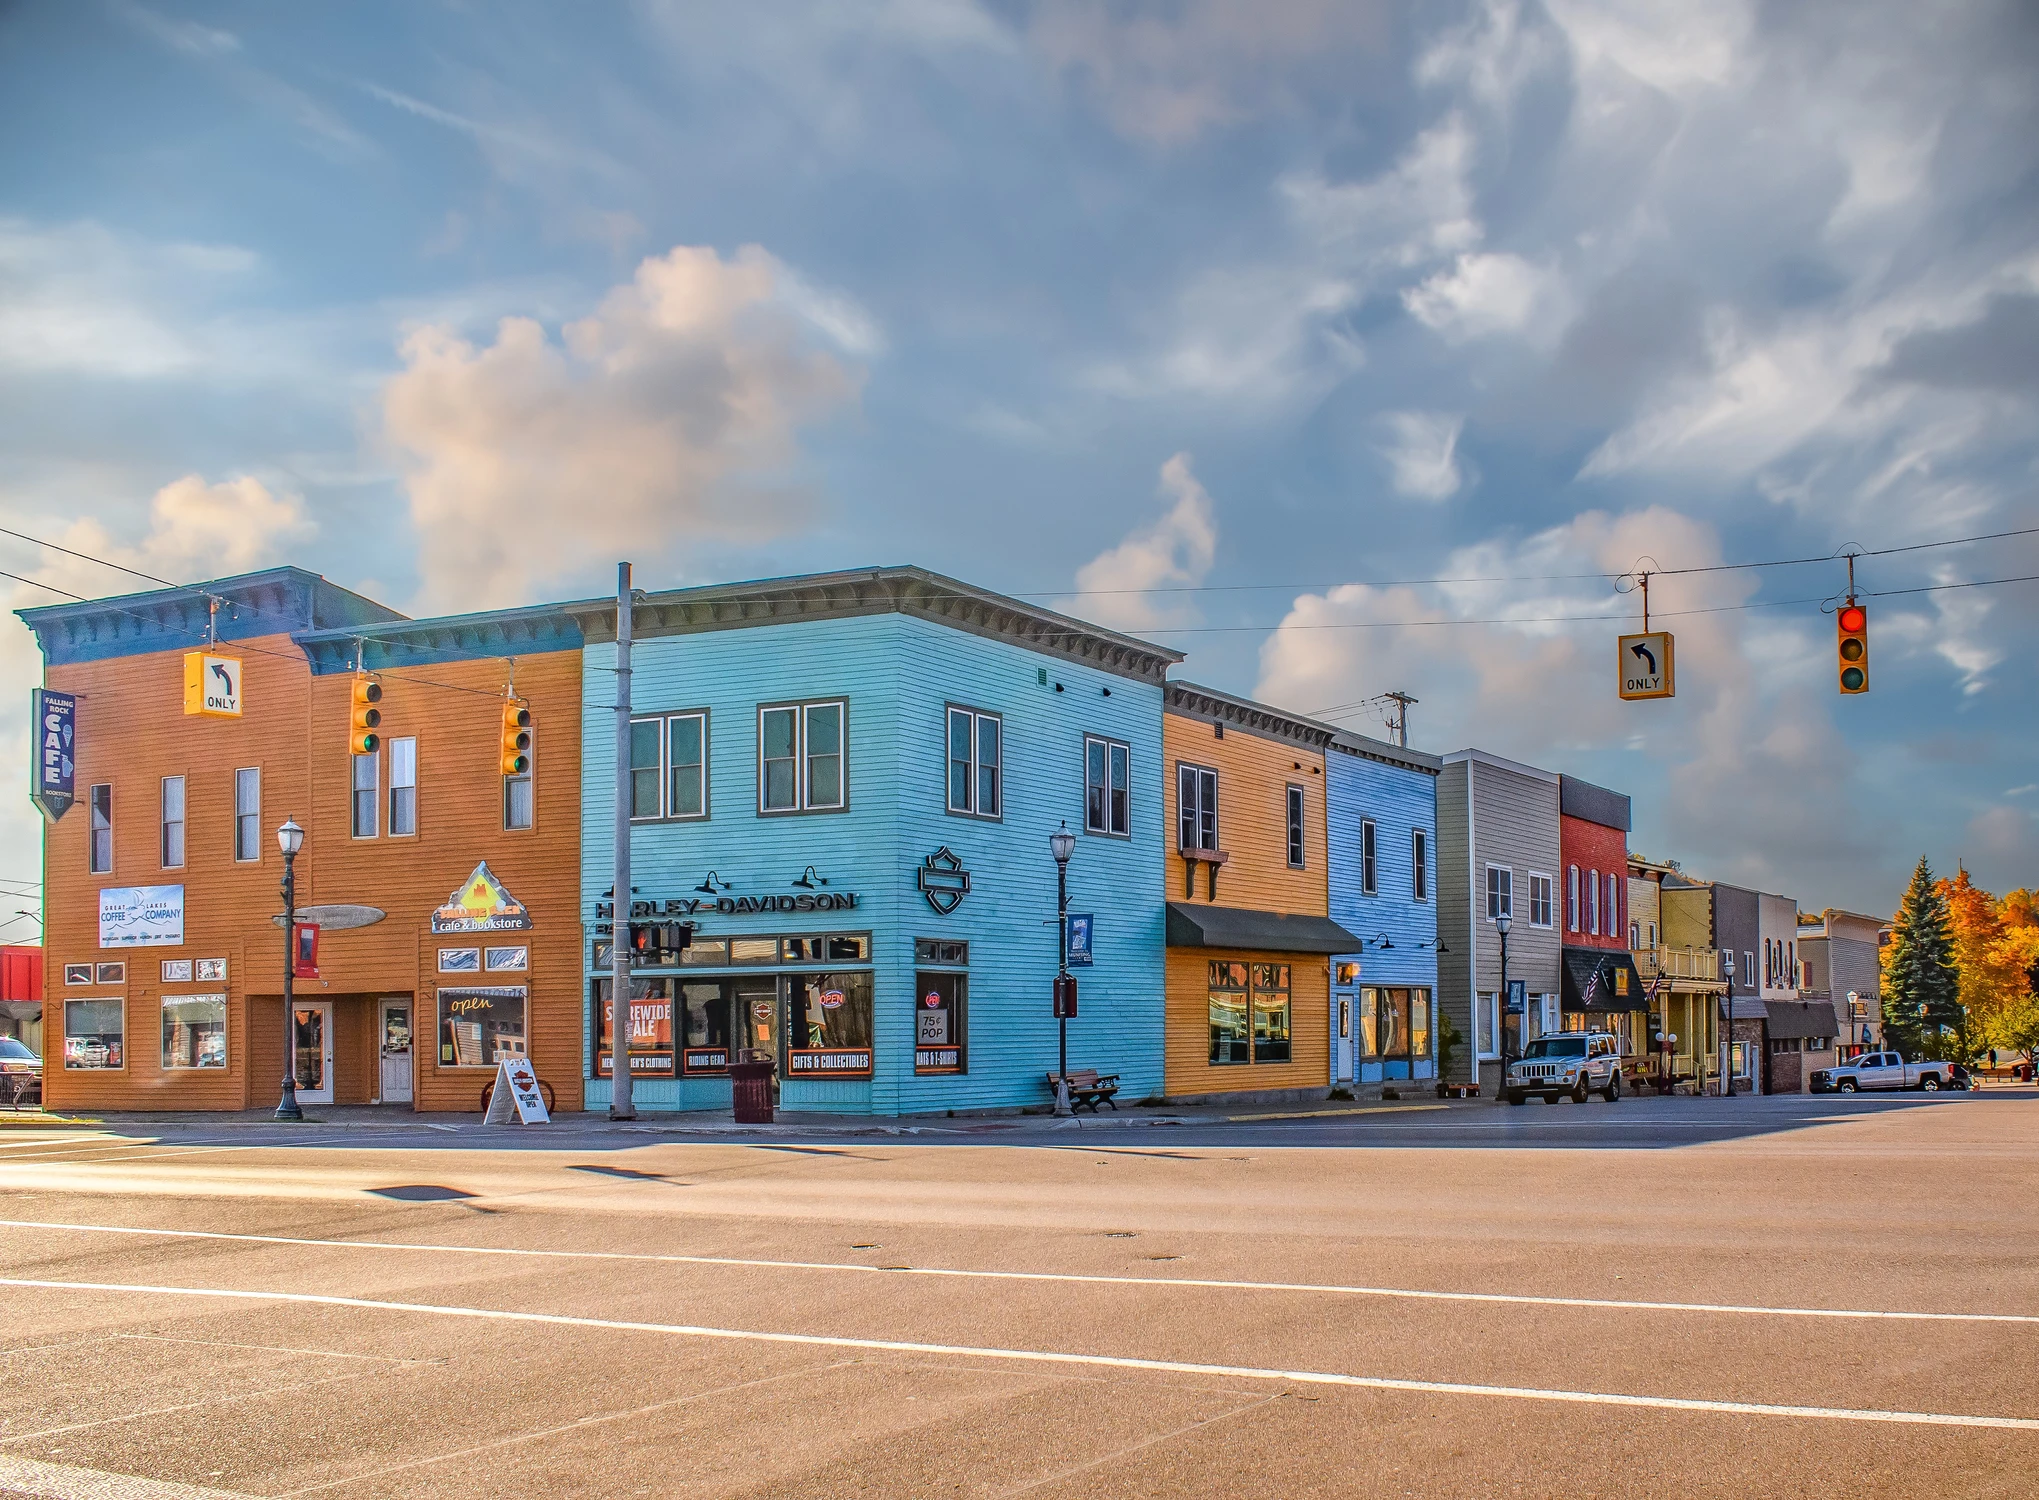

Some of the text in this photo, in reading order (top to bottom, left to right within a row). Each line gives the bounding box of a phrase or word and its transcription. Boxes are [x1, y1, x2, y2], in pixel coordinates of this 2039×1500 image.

[1627, 677, 1660, 690] ONLY
[45, 697, 74, 708] FALLING
[208, 696, 236, 709] ONLY
[49, 705, 69, 715] ROCK
[45, 714, 61, 784] CAFE
[595, 893, 855, 918] HRLEY-DAVIDSON
[101, 909, 182, 921] COFFEE COMPANY
[439, 919, 523, 931] cafe & bookstore
[820, 993, 843, 1004] OPEN
[451, 997, 494, 1016] open
[923, 1016, 941, 1026] 75¢
[633, 1019, 655, 1037] ALE
[921, 1028, 943, 1038] POP
[645, 1057, 672, 1068] CLOTHING
[688, 1054, 725, 1066] RIDING GEAR
[792, 1054, 869, 1069] GIFTS & COLLECTIBLES
